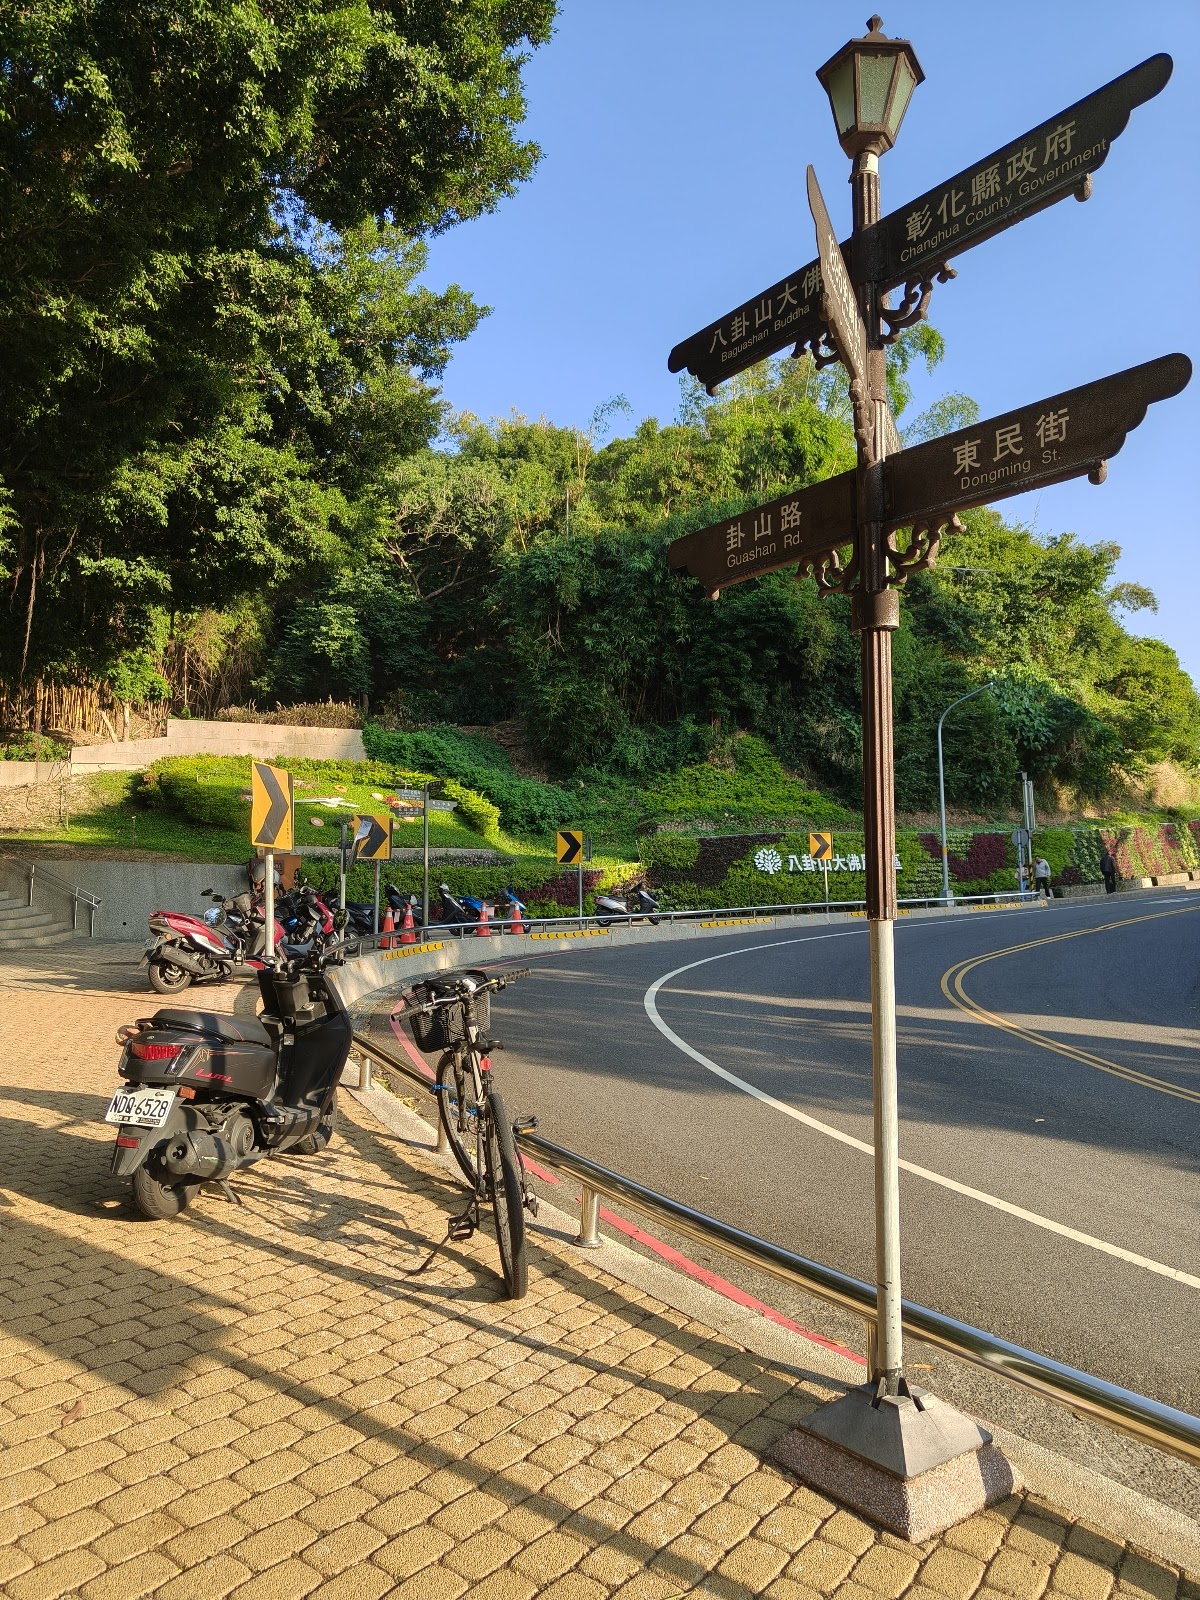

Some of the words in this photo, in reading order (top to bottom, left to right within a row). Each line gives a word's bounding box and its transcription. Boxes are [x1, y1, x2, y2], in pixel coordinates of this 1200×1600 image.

[900, 223, 960, 262] Changhua
[965, 193, 1013, 226] County
[1018, 138, 1108, 196] Government
[905, 120, 1077, 243] 彰化縣政府
[709, 264, 821, 354] 八卦山大佛
[721, 327, 769, 363] Baguashan
[774, 304, 810, 332] Buddha
[953, 407, 1070, 475] 東民街
[961, 459, 1031, 490] Dongming
[1041, 448, 1061, 465] St.
[726, 501, 803, 551] 卦山路
[727, 541, 777, 568] Guashan
[783, 531, 803, 549] Rd.
[788, 853, 903, 872] 八卦山大佛
